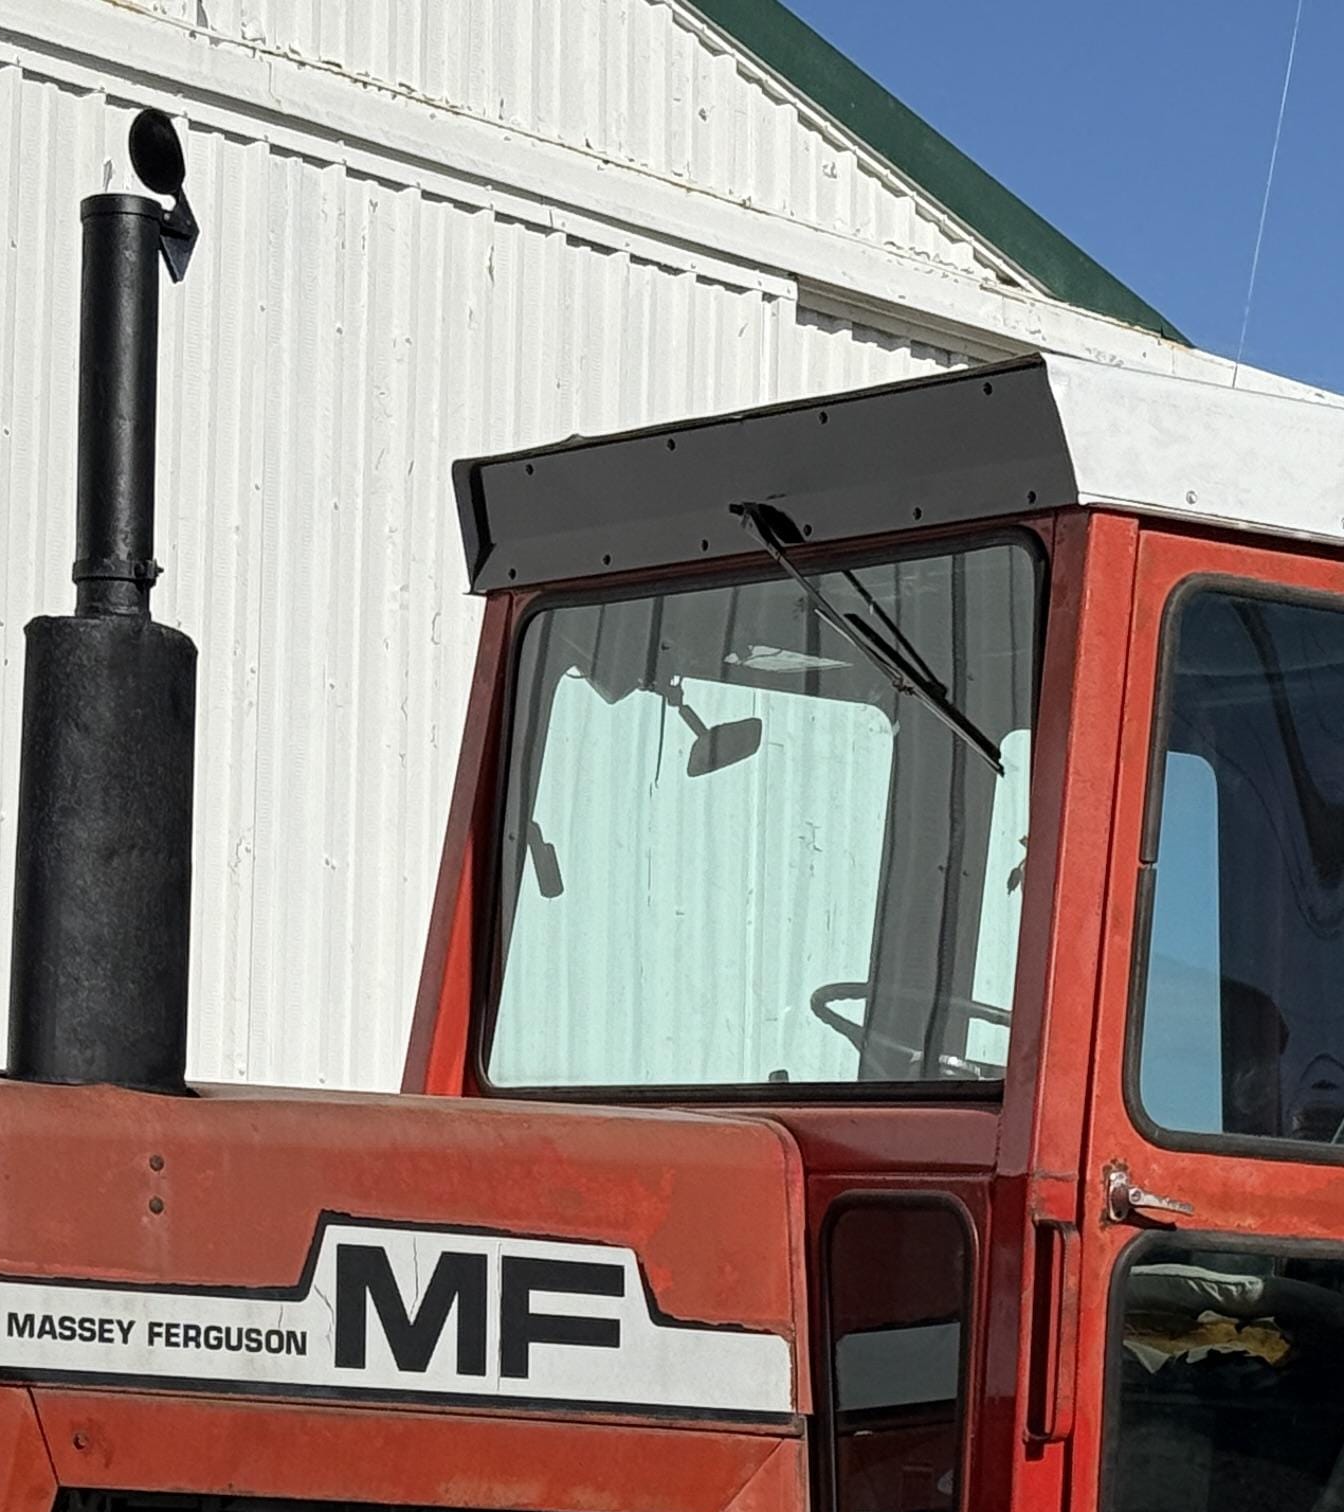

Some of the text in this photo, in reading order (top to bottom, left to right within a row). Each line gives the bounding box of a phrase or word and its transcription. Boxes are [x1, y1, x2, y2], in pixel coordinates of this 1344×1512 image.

[6, 1312, 308, 1356] MASSEY FERGUSON
[334, 1243, 625, 1379] MF
